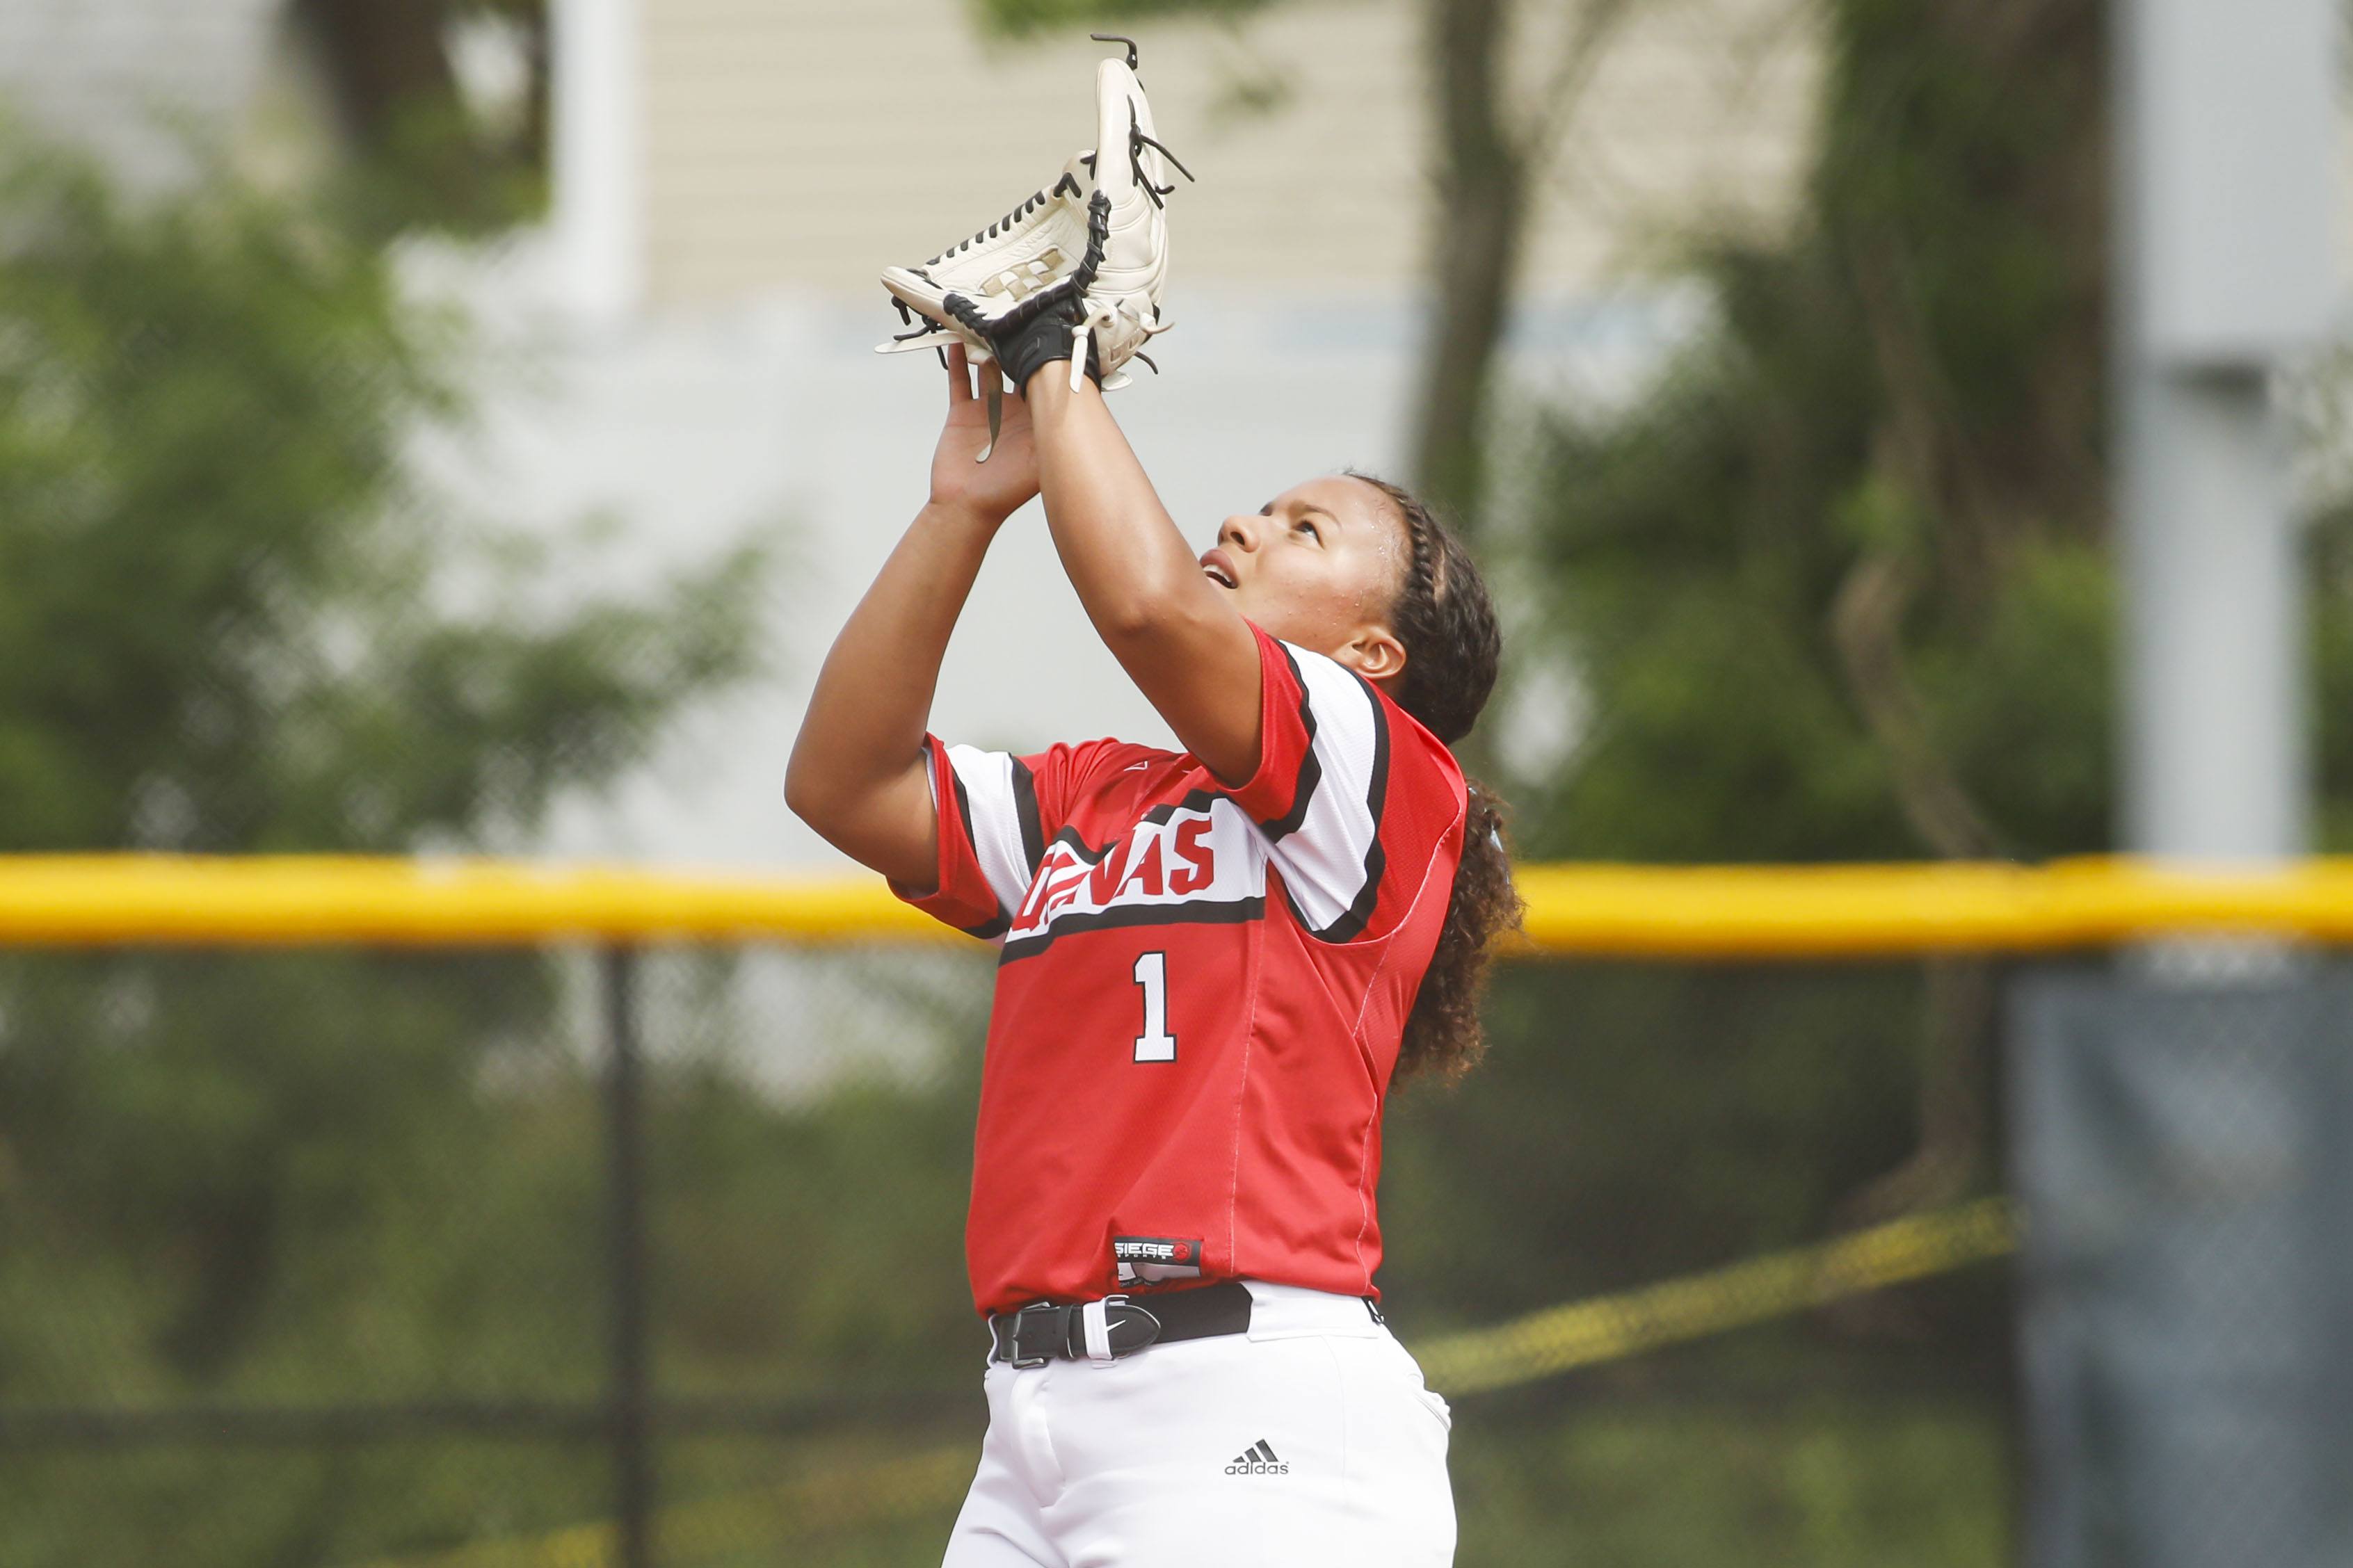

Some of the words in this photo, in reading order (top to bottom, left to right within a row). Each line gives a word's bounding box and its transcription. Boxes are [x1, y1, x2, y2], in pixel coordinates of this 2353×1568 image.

[1134, 951, 1177, 1063] 1
[1114, 1242, 1174, 1256] SIEGE
[1225, 1462, 1288, 1475] adidas
